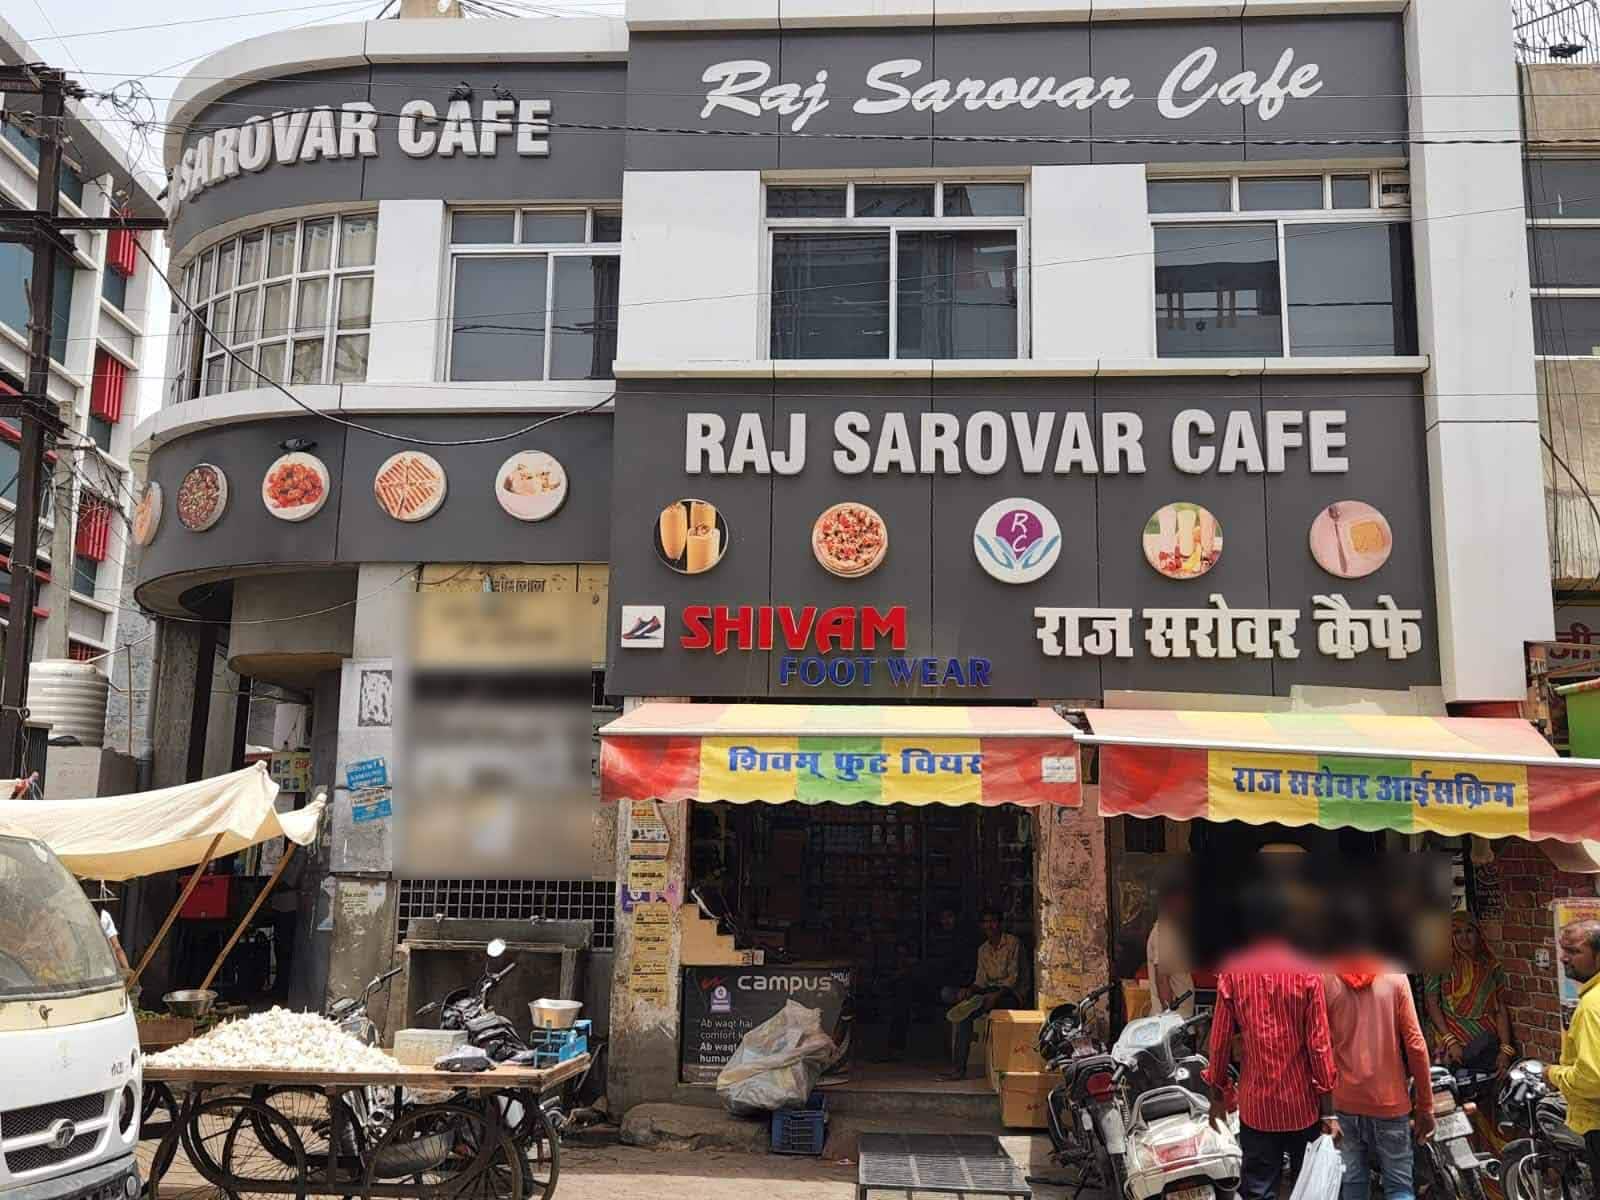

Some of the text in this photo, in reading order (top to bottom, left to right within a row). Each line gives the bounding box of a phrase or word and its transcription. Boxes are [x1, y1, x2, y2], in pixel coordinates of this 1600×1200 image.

[700, 46, 1323, 132] Raj Sarovar Cafe
[180, 101, 378, 200] SAROVAR
[398, 99, 551, 158] CAFE
[685, 409, 1350, 475] RAJ SAROVAR CAFE
[680, 604, 908, 655] SHIVAM
[1034, 593, 1423, 660] राज सरोवर कैफे
[778, 656, 993, 687] FOOT WEAR
[832, 751, 889, 782] फुट
[1231, 767, 1283, 794] राज
[1287, 765, 1370, 801] सरोवर
[737, 975, 832, 995] campus
[700, 1018, 713, 1028] Ab
[715, 1019, 737, 1030] waqt
[700, 1031, 736, 1040] comfort
[700, 1041, 713, 1051] Ab
